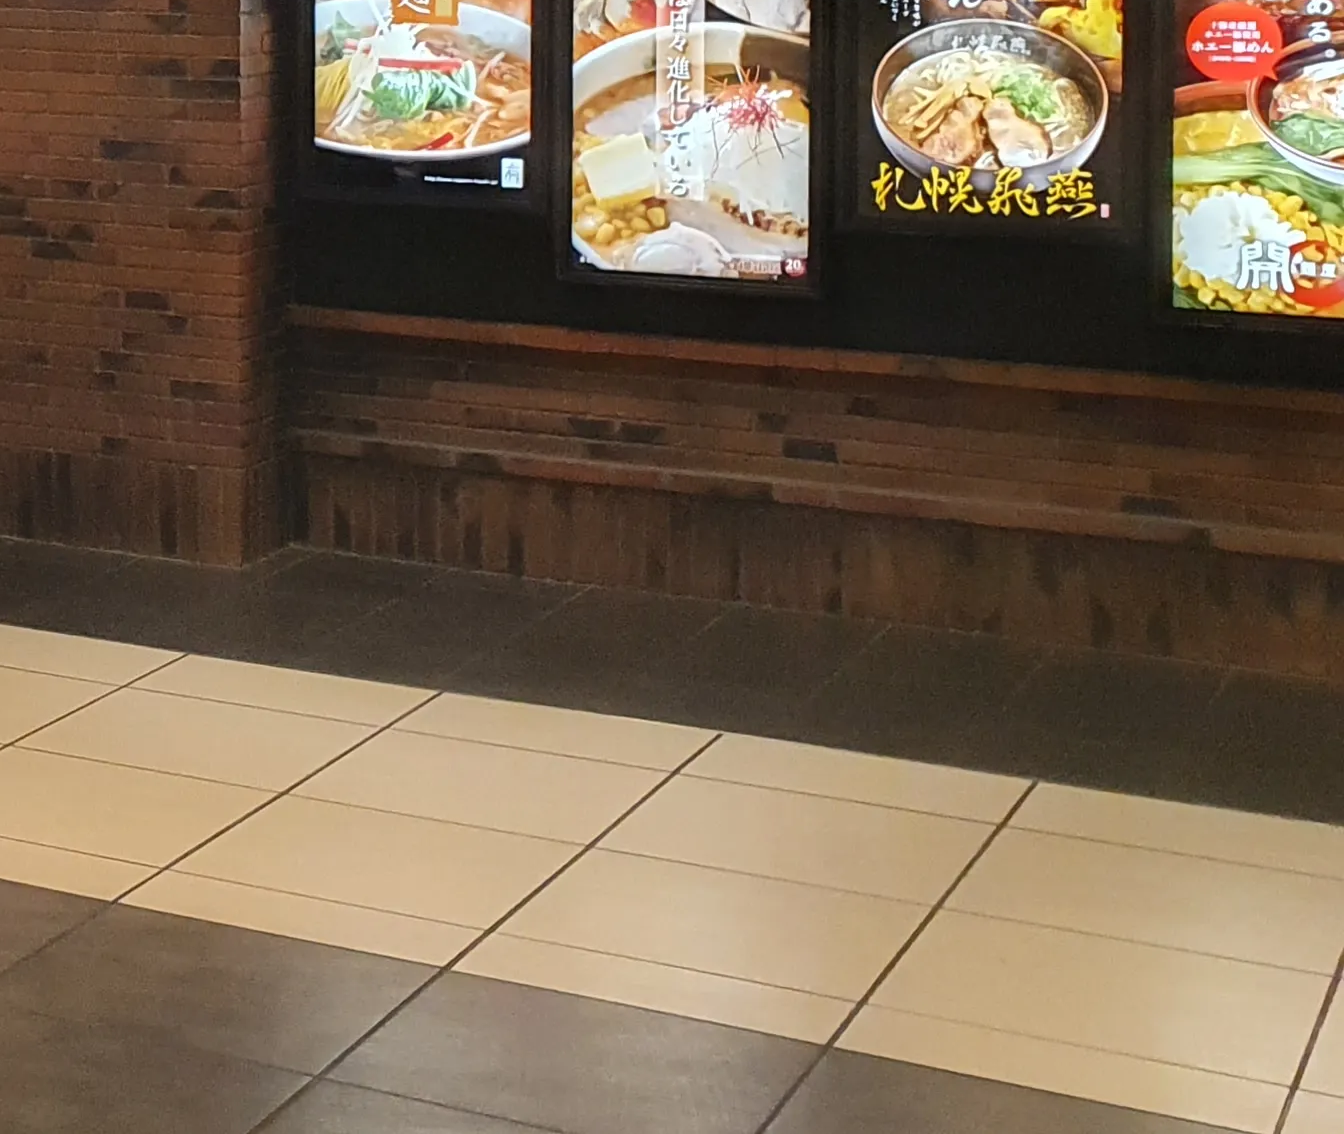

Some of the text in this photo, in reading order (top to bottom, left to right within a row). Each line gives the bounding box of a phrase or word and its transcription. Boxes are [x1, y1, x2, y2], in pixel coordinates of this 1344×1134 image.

[871, 161, 1097, 219] 札幌飛燕
[785, 258, 801, 271] 20
[1236, 240, 1295, 293] 開
